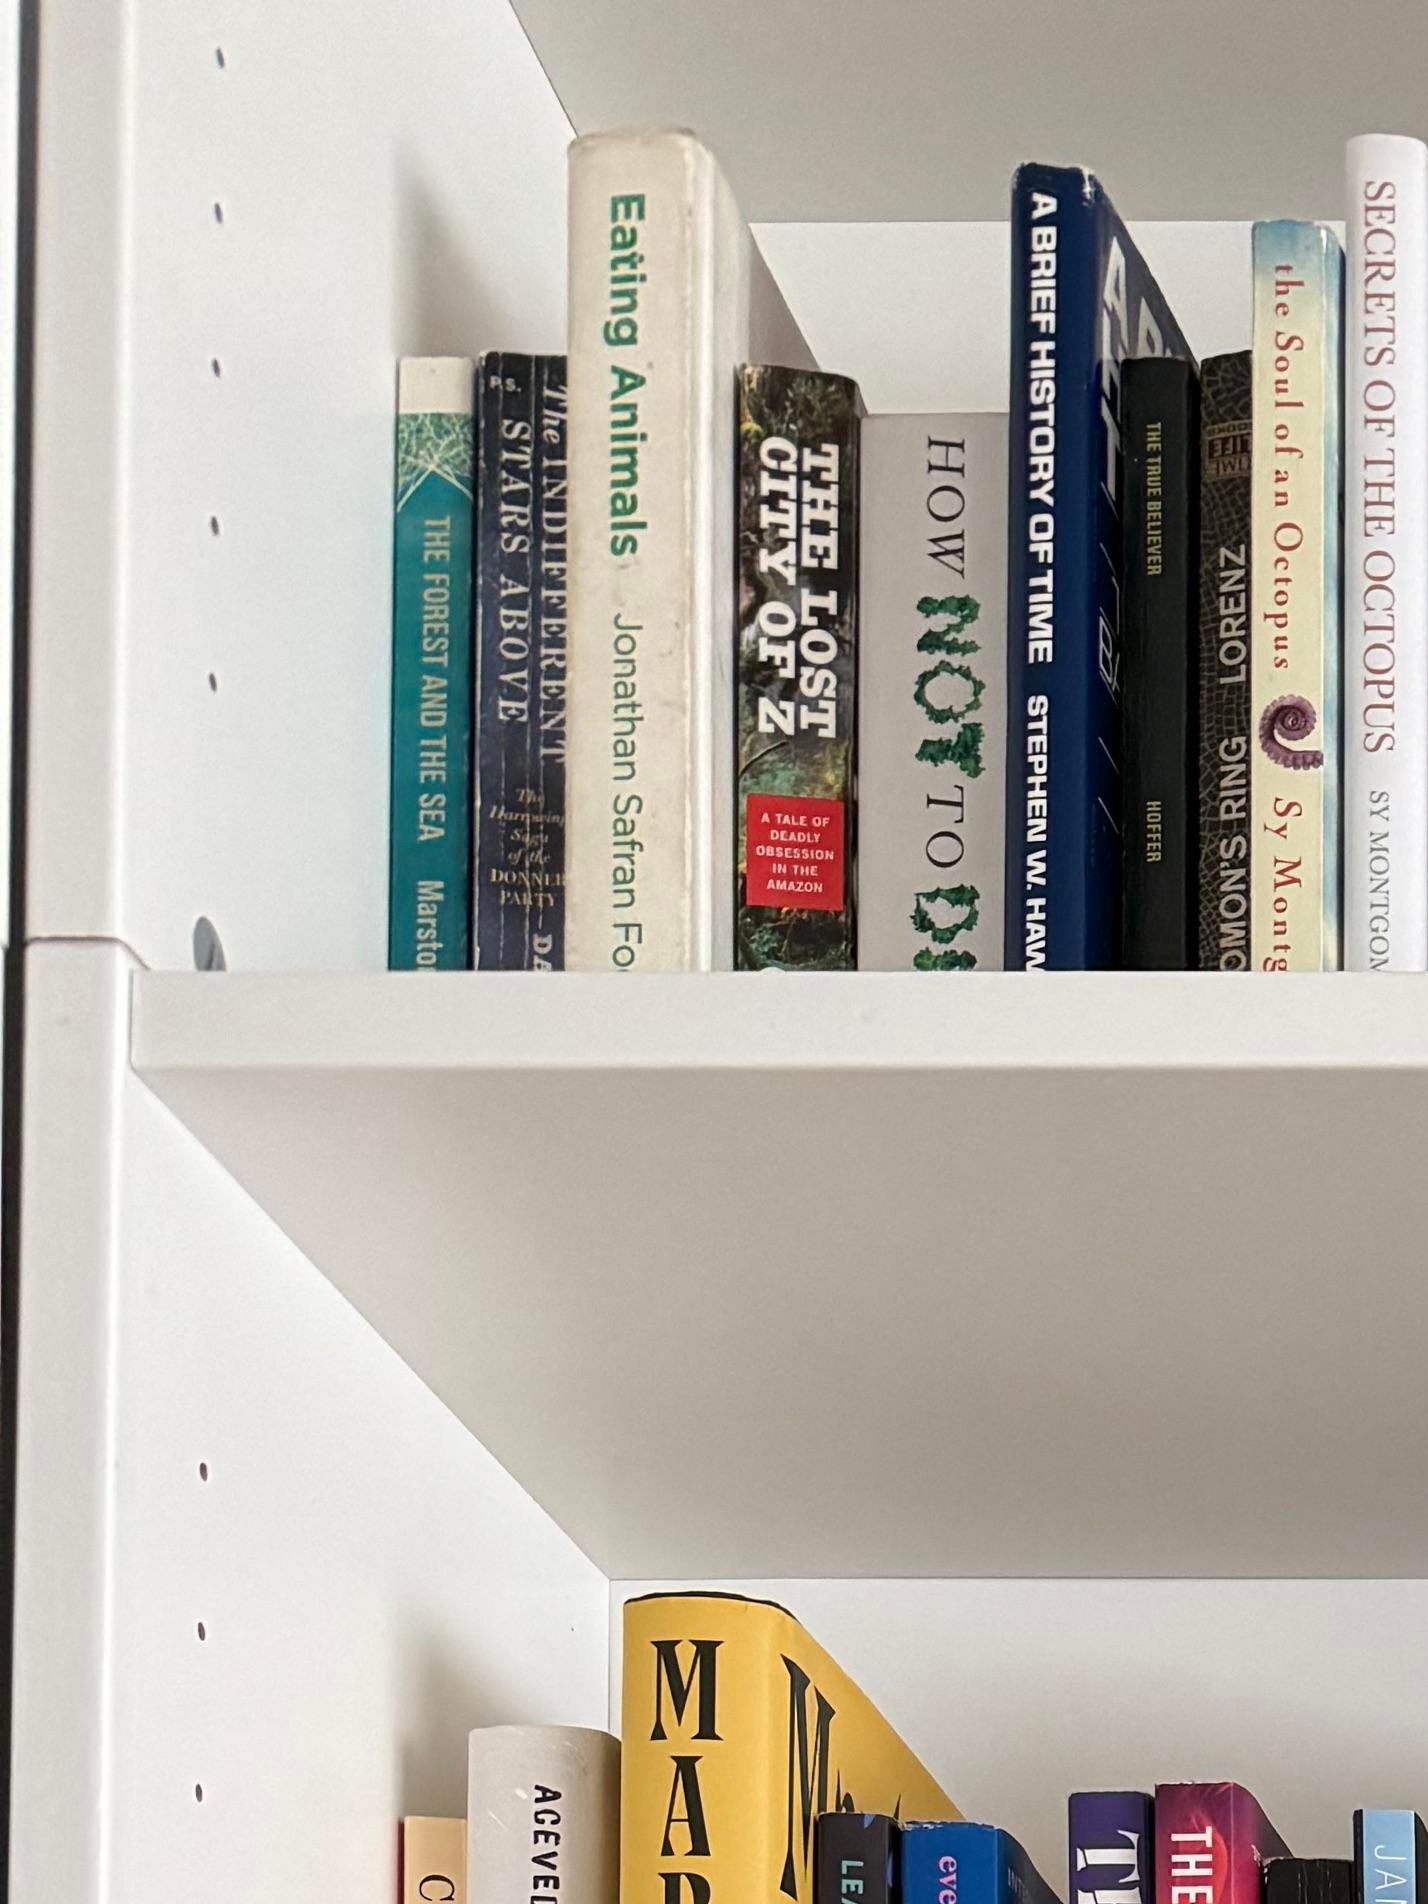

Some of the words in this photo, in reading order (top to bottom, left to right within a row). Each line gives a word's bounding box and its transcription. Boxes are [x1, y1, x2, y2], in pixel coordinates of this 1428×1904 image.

[1032, 193, 1057, 219] A
[603, 194, 647, 346] Eating
[1031, 227, 1056, 333] BRIEF
[1030, 341, 1055, 506] HISTORY
[1147, 422, 1161, 451] THE
[611, 366, 647, 556] Animals
[1147, 455, 1161, 496] TRUE
[757, 437, 797, 585] CITY
[800, 444, 839, 569] THE
[424, 516, 450, 562] THE
[1029, 514, 1054, 566] OF
[1147, 501, 1161, 575] BELIEVER
[422, 574, 449, 667] FOREST
[759, 601, 796, 678] OF
[1029, 569, 1053, 663] TIME
[800, 594, 837, 738] LOST
[420, 675, 447, 726] AND
[758, 696, 794, 735] Z
[420, 736, 446, 783] THE
[418, 794, 446, 840] SEA
[762, 813, 770, 823] A
[775, 815, 807, 825] TALE
[813, 817, 831, 827] OF
[770, 831, 821, 842] DEADLY
[1147, 801, 1161, 862] HOFFER
[756, 846, 834, 860] OBSESSION
[773, 865, 786, 874] IN
[793, 866, 819, 876] THE
[767, 881, 823, 893] AMAZON
[1172, 1826, 1213, 1904] THE
